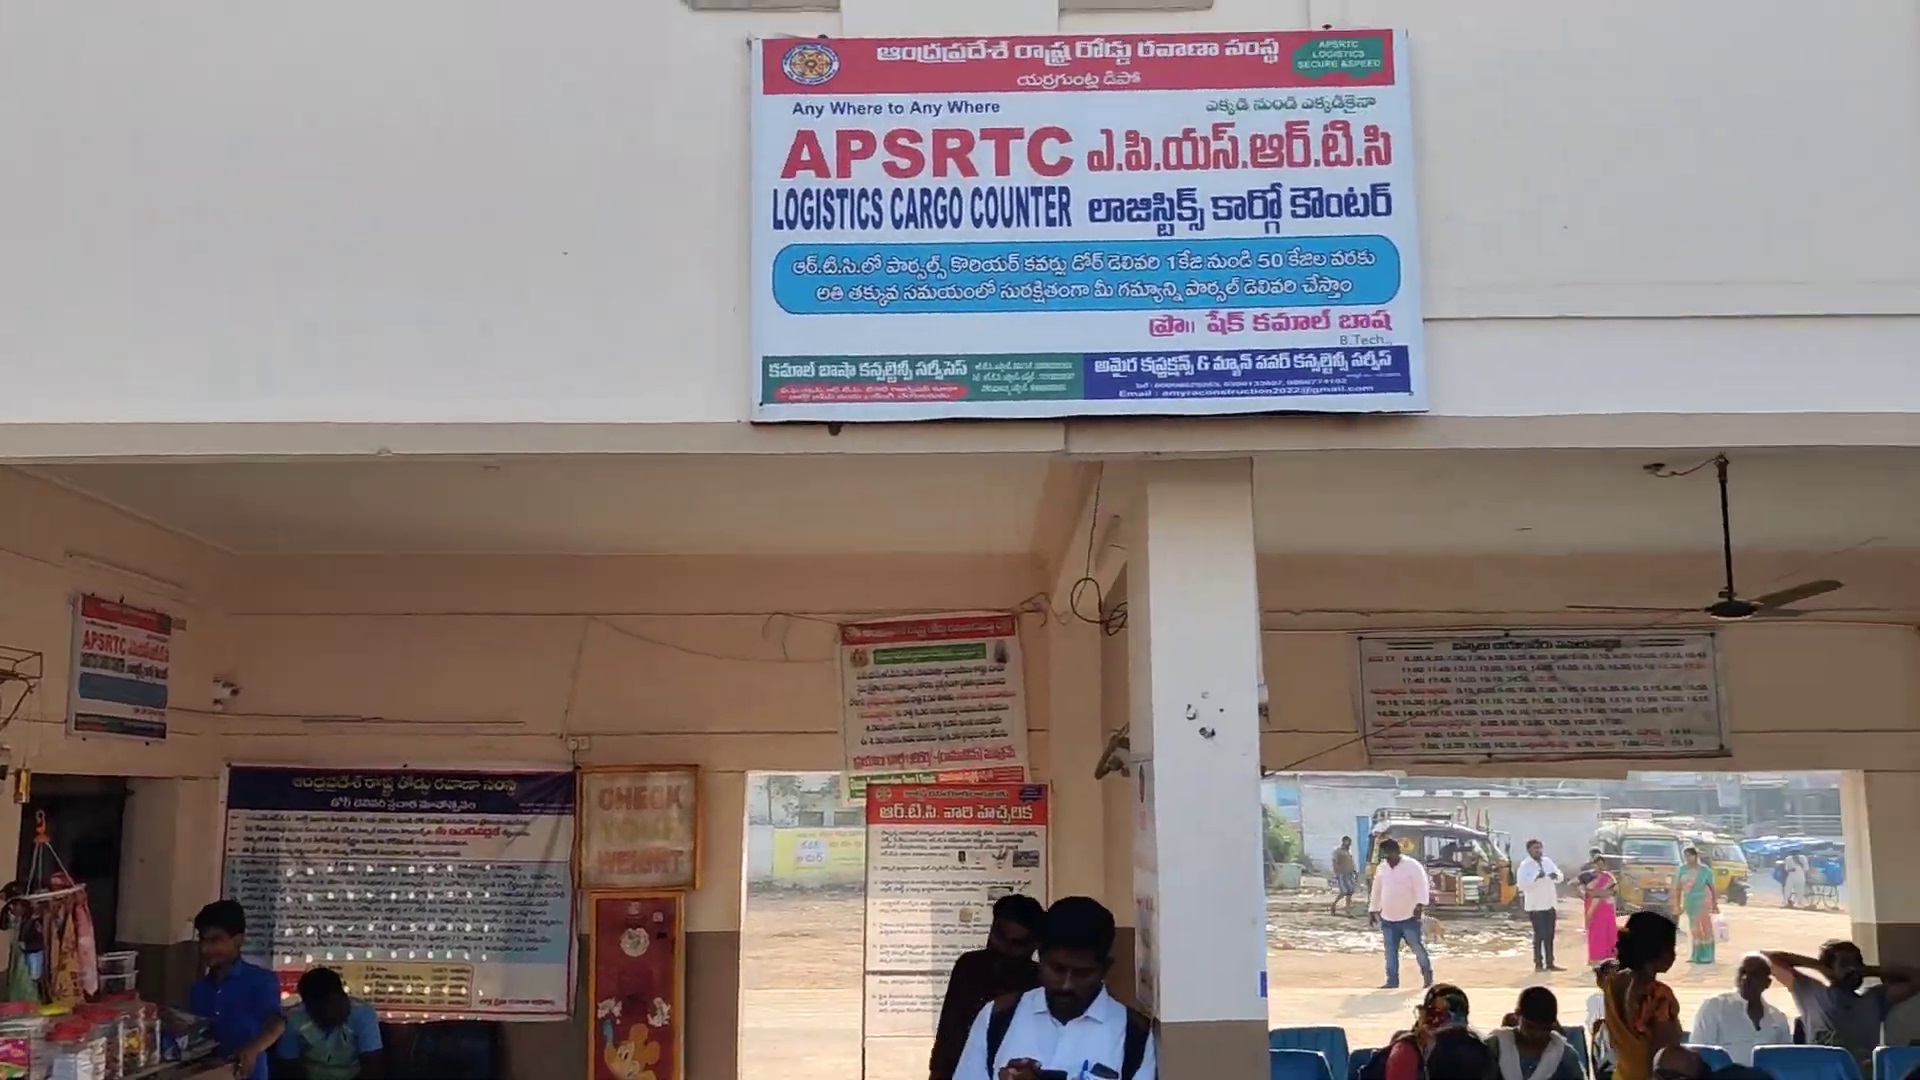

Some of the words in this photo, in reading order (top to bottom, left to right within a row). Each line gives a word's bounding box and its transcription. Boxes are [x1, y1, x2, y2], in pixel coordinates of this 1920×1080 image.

[1318, 40, 1360, 49] APSRTC
[1311, 50, 1366, 59] LOGISTICS
[1296, 60, 1339, 69] SECURE
[792, 102, 825, 118] Any
[830, 100, 884, 116] Where
[888, 101, 905, 116] to
[909, 100, 943, 117] Any
[947, 99, 1001, 114] Where
[780, 126, 1074, 179] APSRTC
[771, 187, 883, 231] LOGISTICS
[889, 186, 963, 230] CARGO
[970, 185, 1073, 229] COUNTER
[1258, 252, 1283, 269] 50
[1197, 354, 1211, 372] &
[1118, 389, 1153, 398] Email
[598, 785, 684, 812] CHECK
